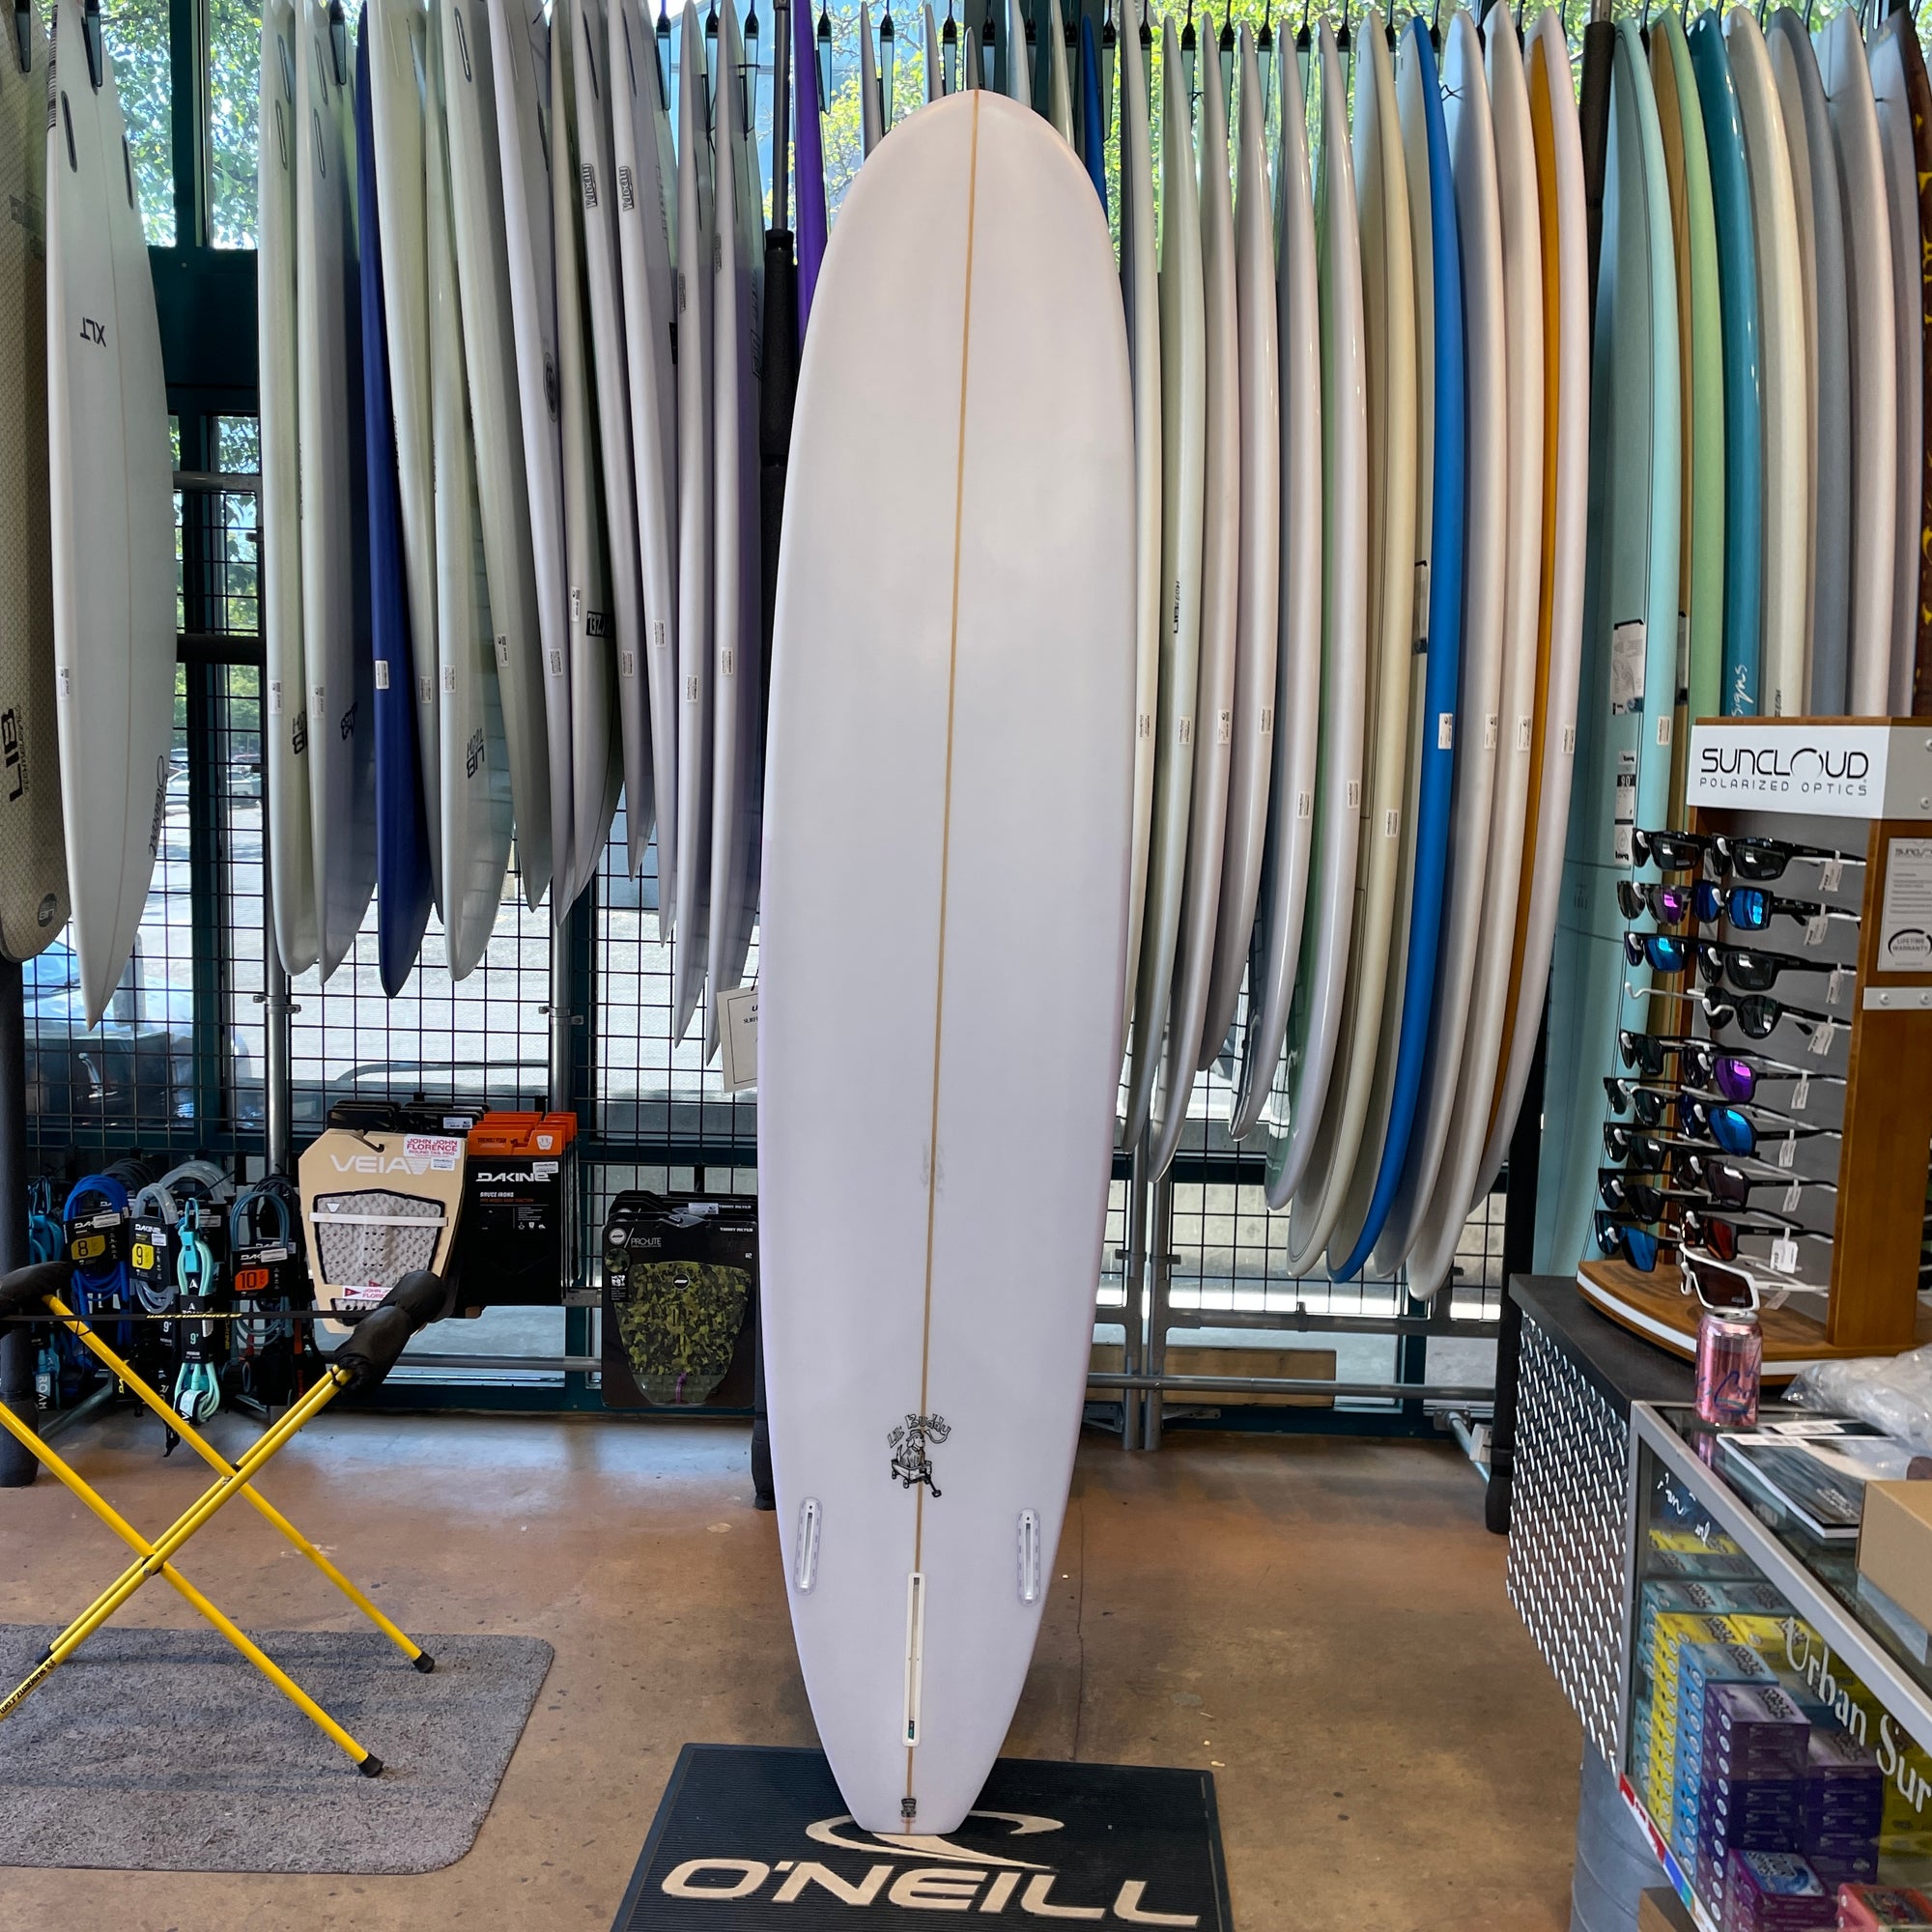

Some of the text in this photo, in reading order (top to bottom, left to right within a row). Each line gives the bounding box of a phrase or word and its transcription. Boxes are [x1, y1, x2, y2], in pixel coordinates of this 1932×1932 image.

[582, 164, 597, 209] Velocity
[619, 166, 635, 212] Velocity
[80, 317, 106, 348] XLT
[2, 708, 23, 802] LIB
[1700, 748, 1869, 780] SUNCLOUD
[1699, 777, 1867, 796] POLARIZED OPTICS
[407, 1144, 458, 1152] FLORENCE
[329, 1154, 412, 1175] VEIA
[475, 1173, 551, 1181] DAKINE
[78, 1240, 89, 1257] 8
[136, 1245, 144, 1265] 9
[241, 1271, 258, 1289] 10
[38, 1376, 47, 1410] ROAM
[1787, 1616, 1867, 1747] Urban
[661, 1858, 1200, 1928] O'NEILL
